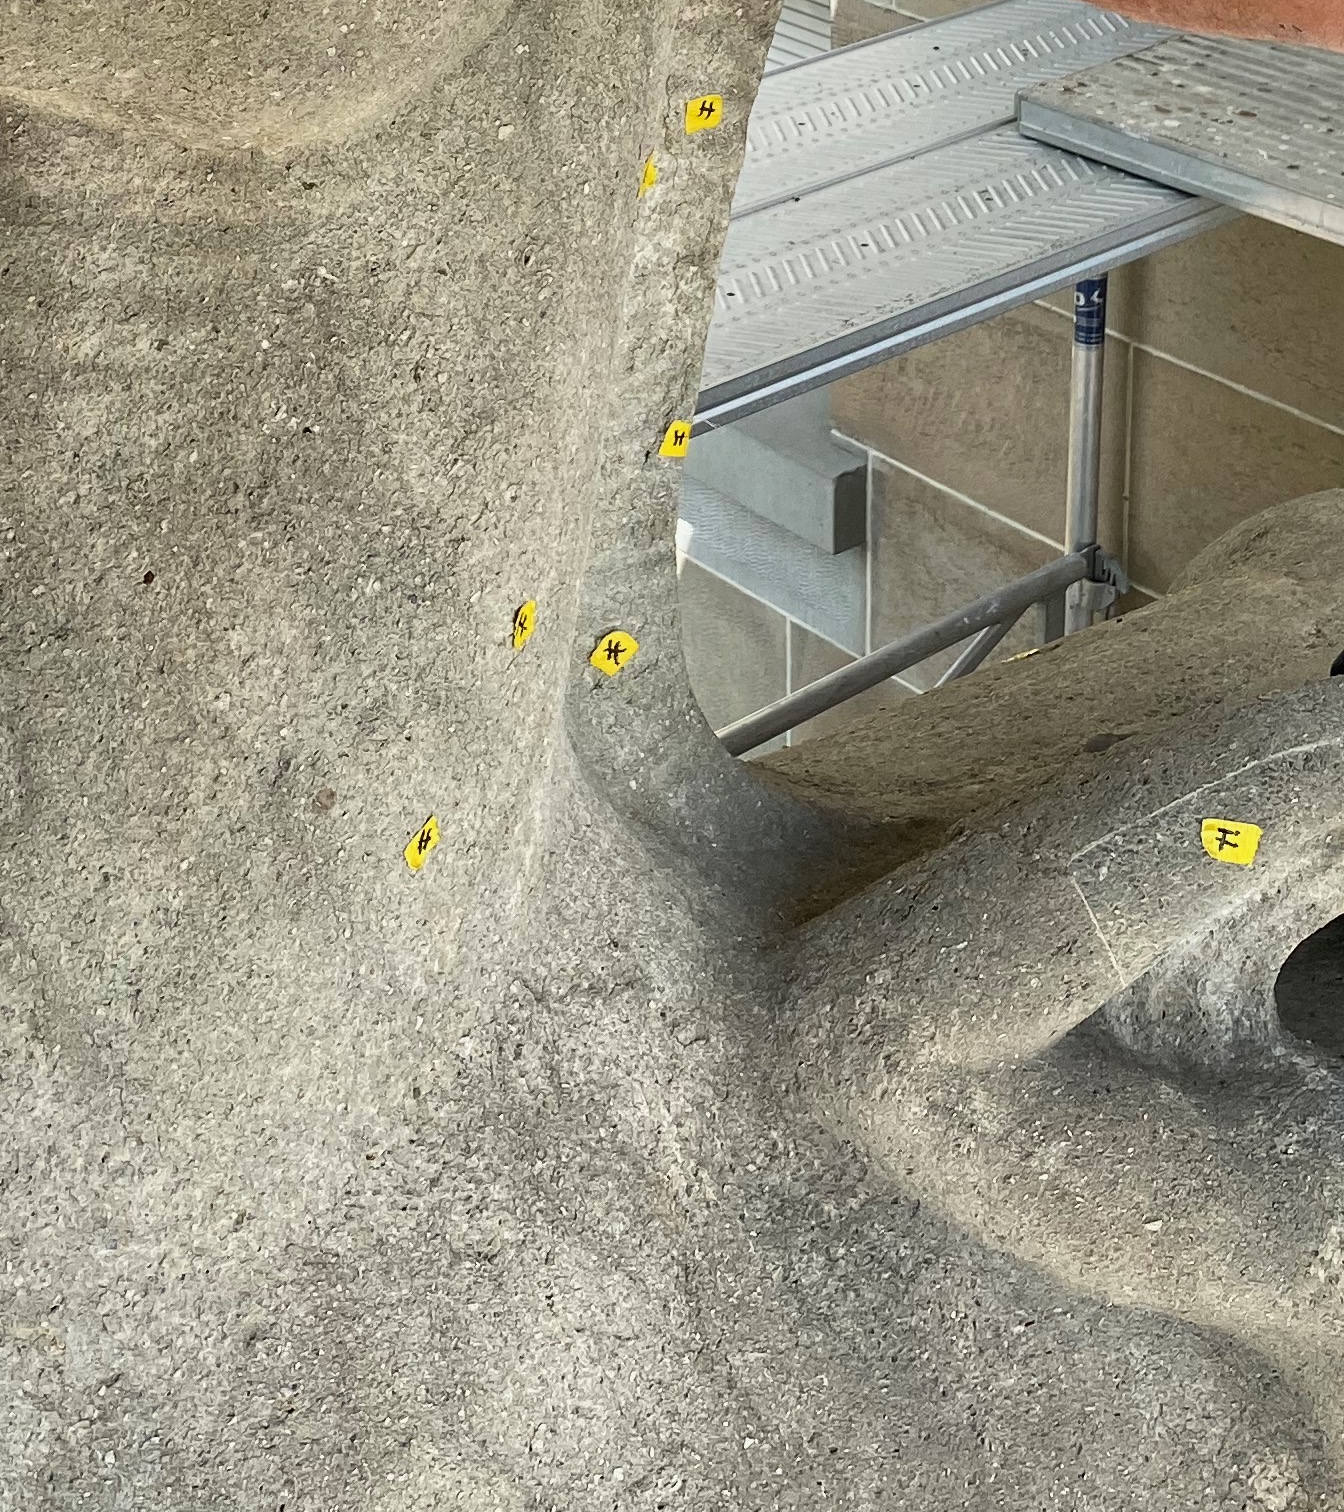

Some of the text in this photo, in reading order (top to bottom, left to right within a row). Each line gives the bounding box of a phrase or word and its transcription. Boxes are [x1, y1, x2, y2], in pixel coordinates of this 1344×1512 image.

[697, 100, 716, 120] H
[672, 429, 685, 447] H
[602, 639, 627, 666] H
[417, 828, 432, 855] H
